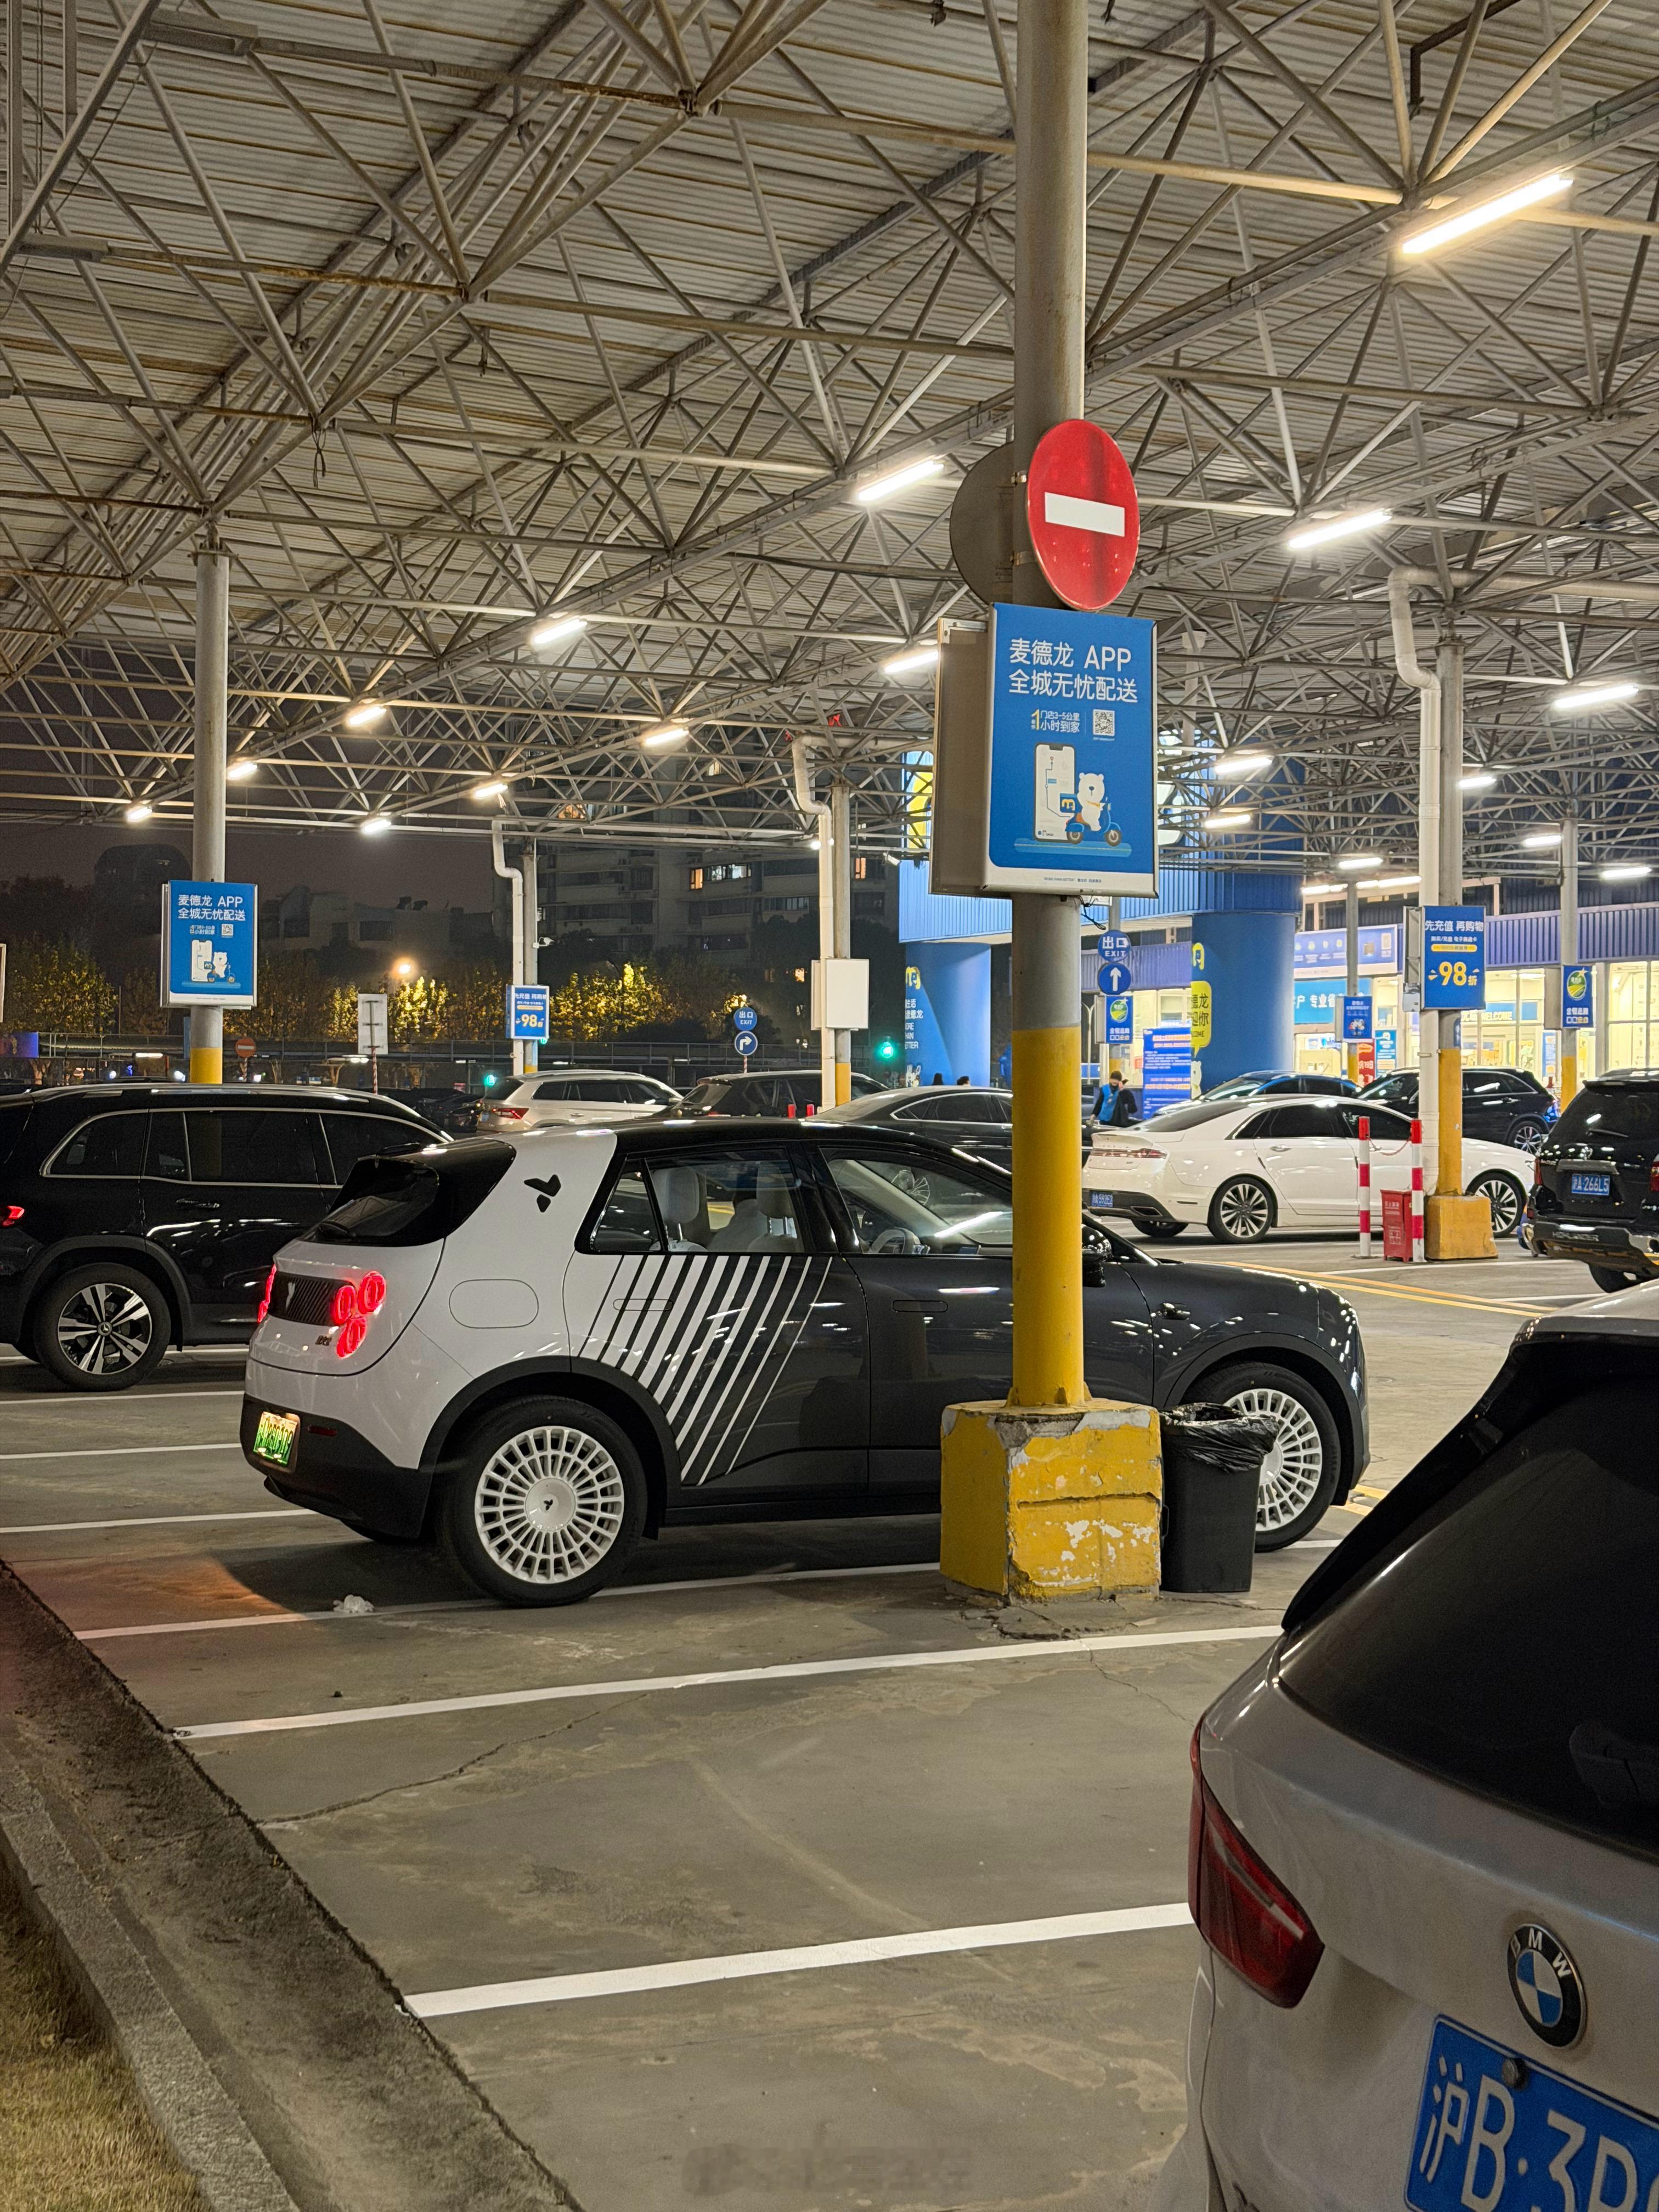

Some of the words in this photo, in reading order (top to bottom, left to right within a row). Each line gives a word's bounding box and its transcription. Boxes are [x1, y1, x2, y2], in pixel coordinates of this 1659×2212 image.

[1009, 637, 1074, 668] 麦德龙
[1084, 644, 1132, 673] APP
[1009, 669, 1138, 703] 全城无忧配送
[178, 894, 213, 907] 麦德龙
[217, 896, 243, 908] APP
[178, 907, 246, 921] 全城无忧配送
[1425, 920, 1454, 932] 先充值
[1455, 921, 1484, 932] 再购物
[1102, 936, 1128, 949] 出口
